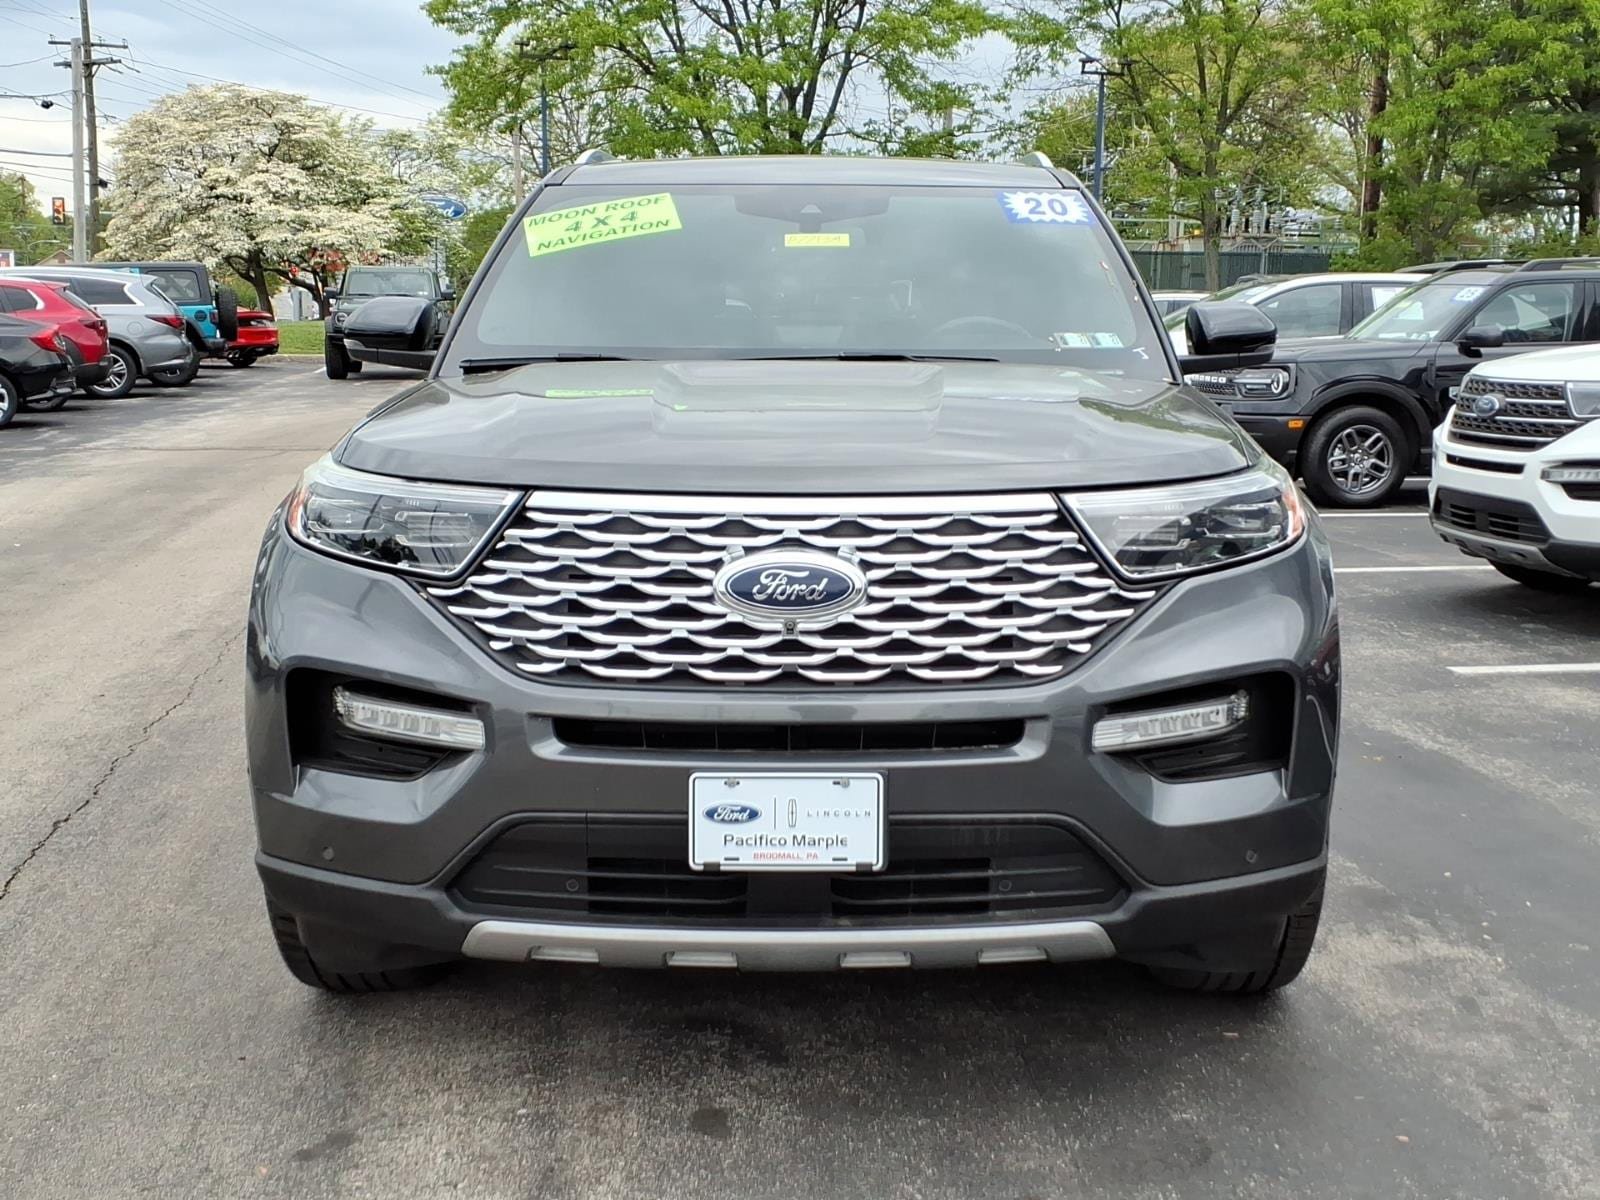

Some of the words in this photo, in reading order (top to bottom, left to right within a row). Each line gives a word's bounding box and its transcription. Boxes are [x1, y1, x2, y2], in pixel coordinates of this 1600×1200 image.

[529, 207, 597, 227] MOON
[605, 196, 666, 213] ROOF
[1024, 197, 1068, 216] 20
[537, 219, 671, 251] NAVIGATION
[752, 569, 829, 600] Ford
[713, 805, 751, 822] Ford
[806, 807, 872, 817] LINCOLN
[724, 834, 787, 847] Pacifico
[792, 834, 848, 850] Marple
[806, 852, 819, 860] PA
